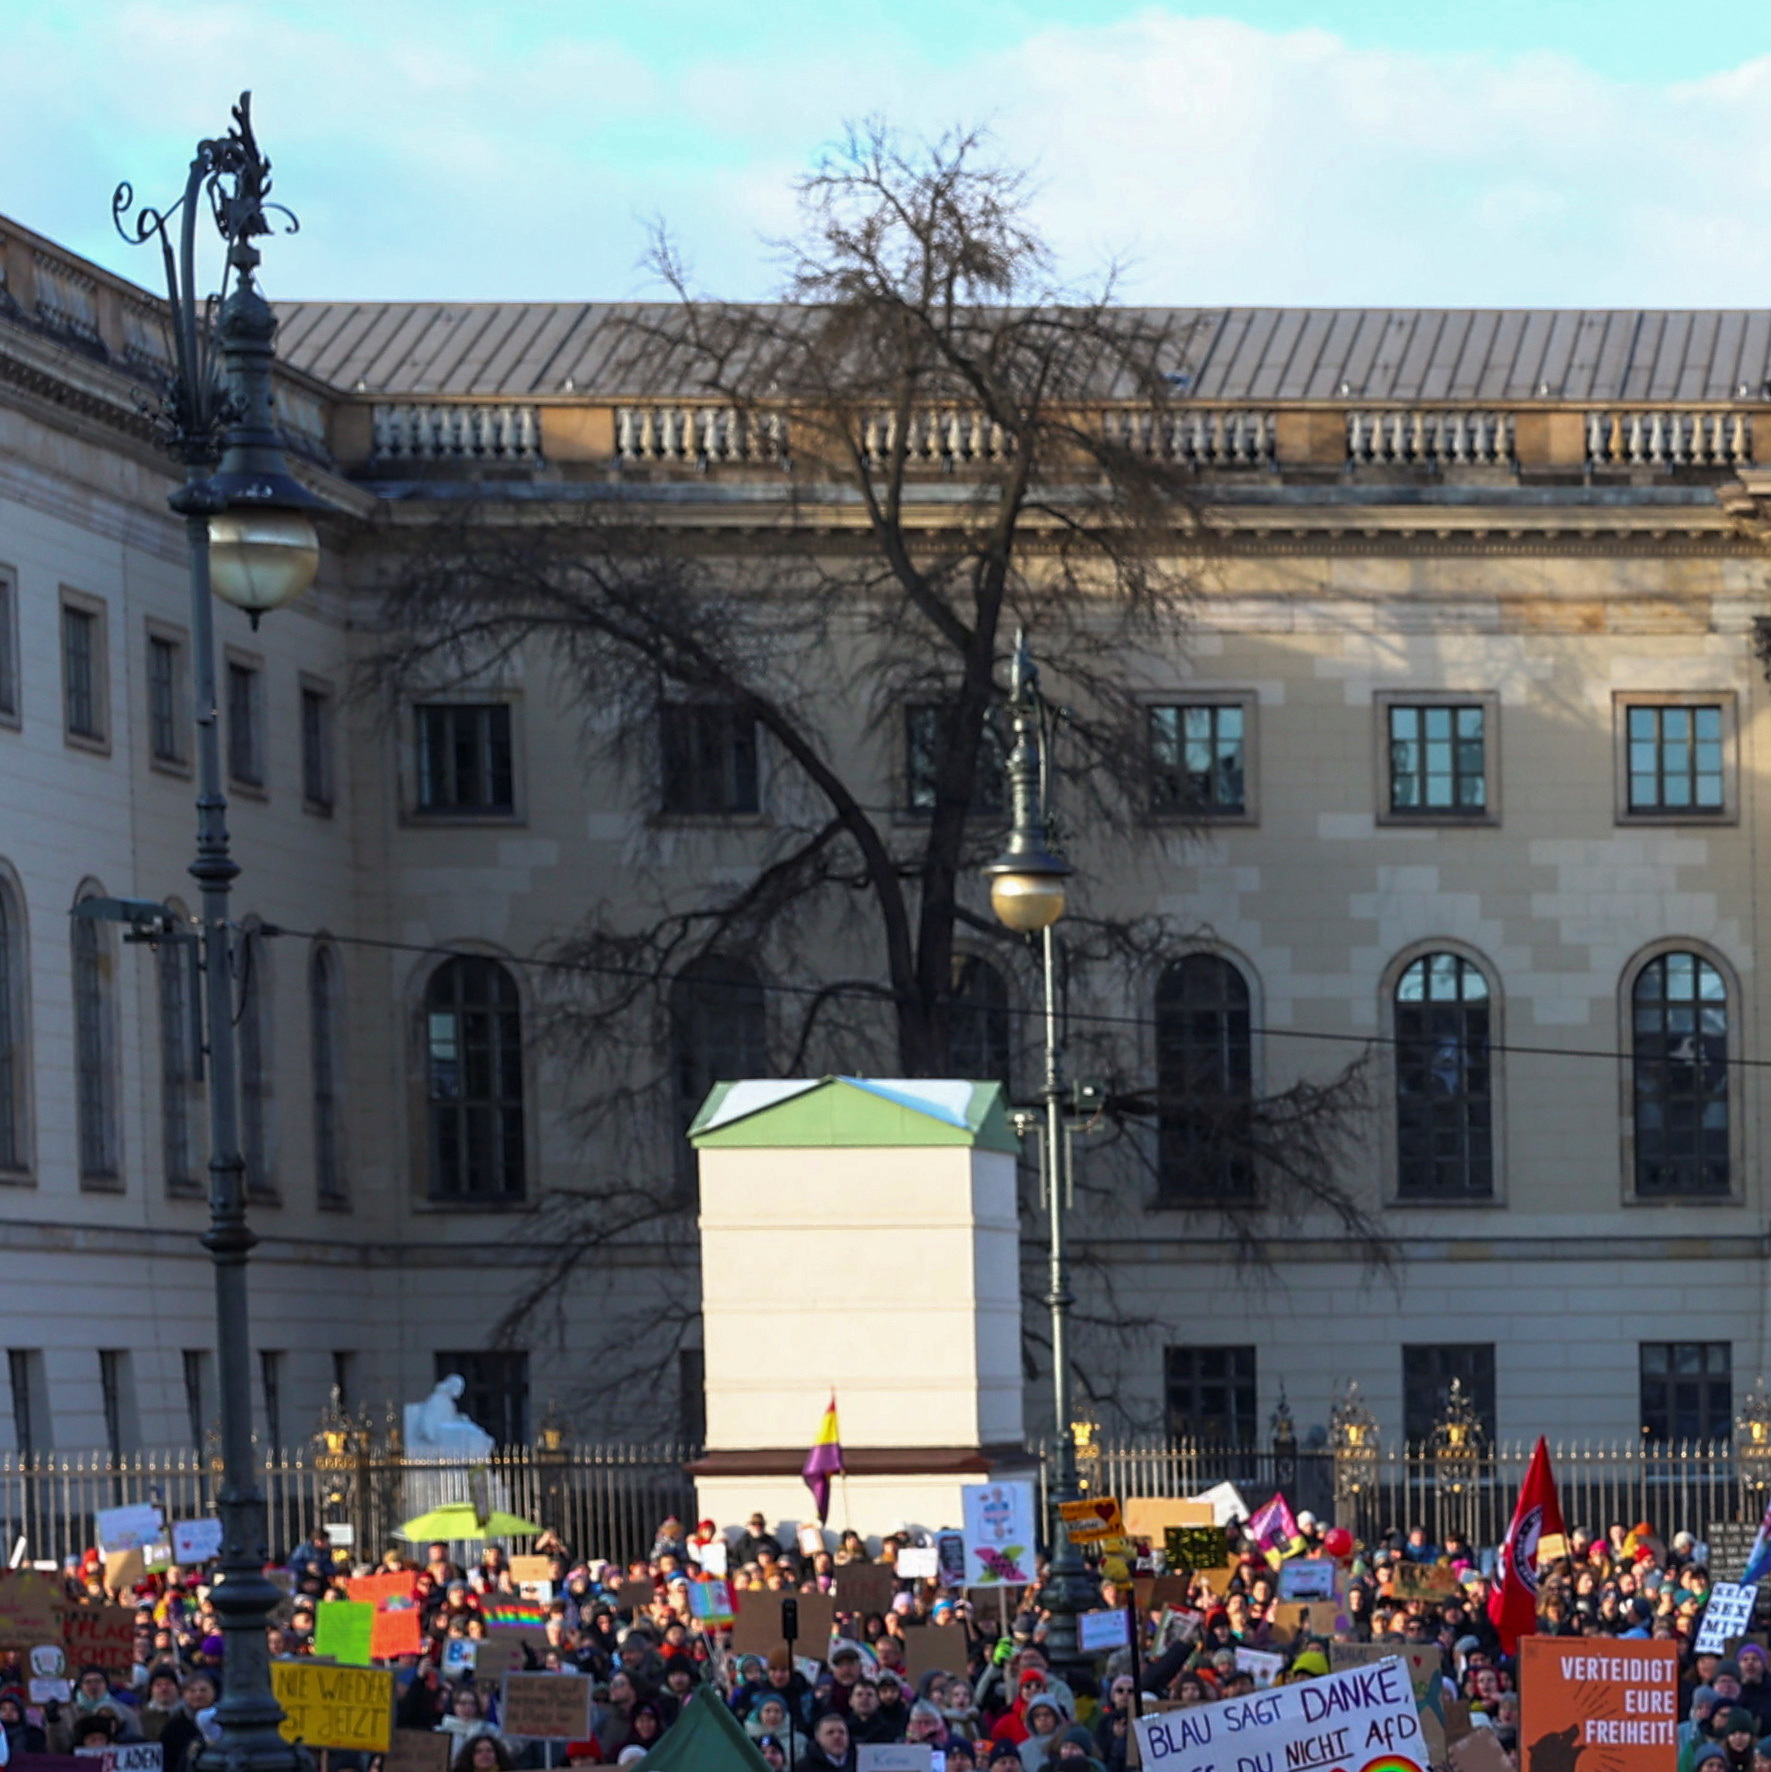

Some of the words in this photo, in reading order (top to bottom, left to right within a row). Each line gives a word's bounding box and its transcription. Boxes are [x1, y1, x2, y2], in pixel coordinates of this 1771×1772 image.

[1561, 1656, 1675, 1682] VERTEIDIGT
[1148, 1718, 1213, 1759] BLAU
[1223, 1694, 1284, 1733] SAGT
[1301, 1665, 1411, 1725] DANKE,
[1625, 1689, 1675, 1714] EURE
[317, 1705, 388, 1741] JETZT
[1586, 1719, 1675, 1745] FREIHEIT!
[1286, 1726, 1350, 1768] NICHT
[1365, 1713, 1419, 1752] AfD
